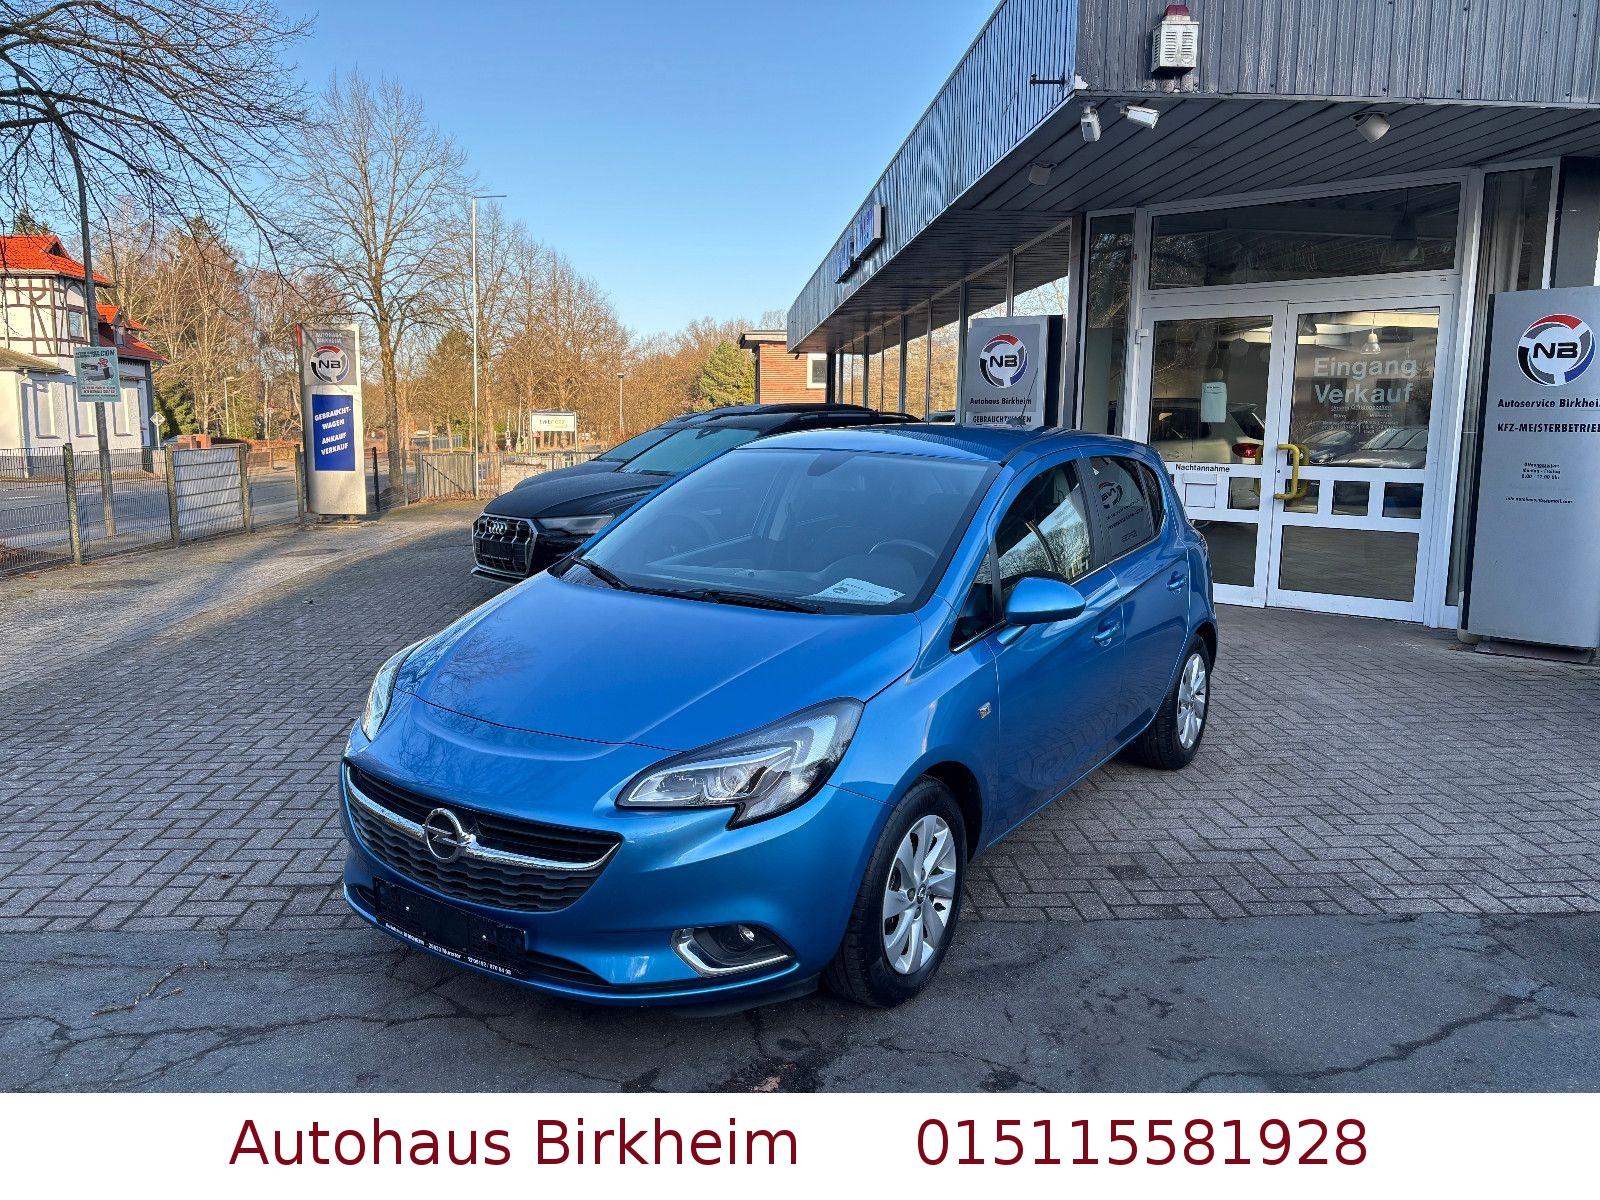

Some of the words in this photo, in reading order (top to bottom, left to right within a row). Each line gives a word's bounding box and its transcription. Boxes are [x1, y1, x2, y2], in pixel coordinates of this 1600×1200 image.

[1532, 341, 1578, 359] NB
[318, 359, 341, 369] NB
[989, 354, 1018, 368] NB
[1313, 357, 1418, 380] Eingang
[1314, 382, 1414, 404] Verkauf
[969, 397, 1000, 405] Autohaus
[1001, 396, 1032, 405] Birkheim
[1497, 398, 1556, 408] Autoservice
[1559, 397, 1600, 408] Birkhei
[314, 406, 352, 422] GEBRAUCHT-
[321, 418, 345, 430] WAGEN
[321, 431, 347, 444] ANKAUF
[320, 442, 349, 456] VERKAUF
[1175, 463, 1231, 473] Nachtannahme
